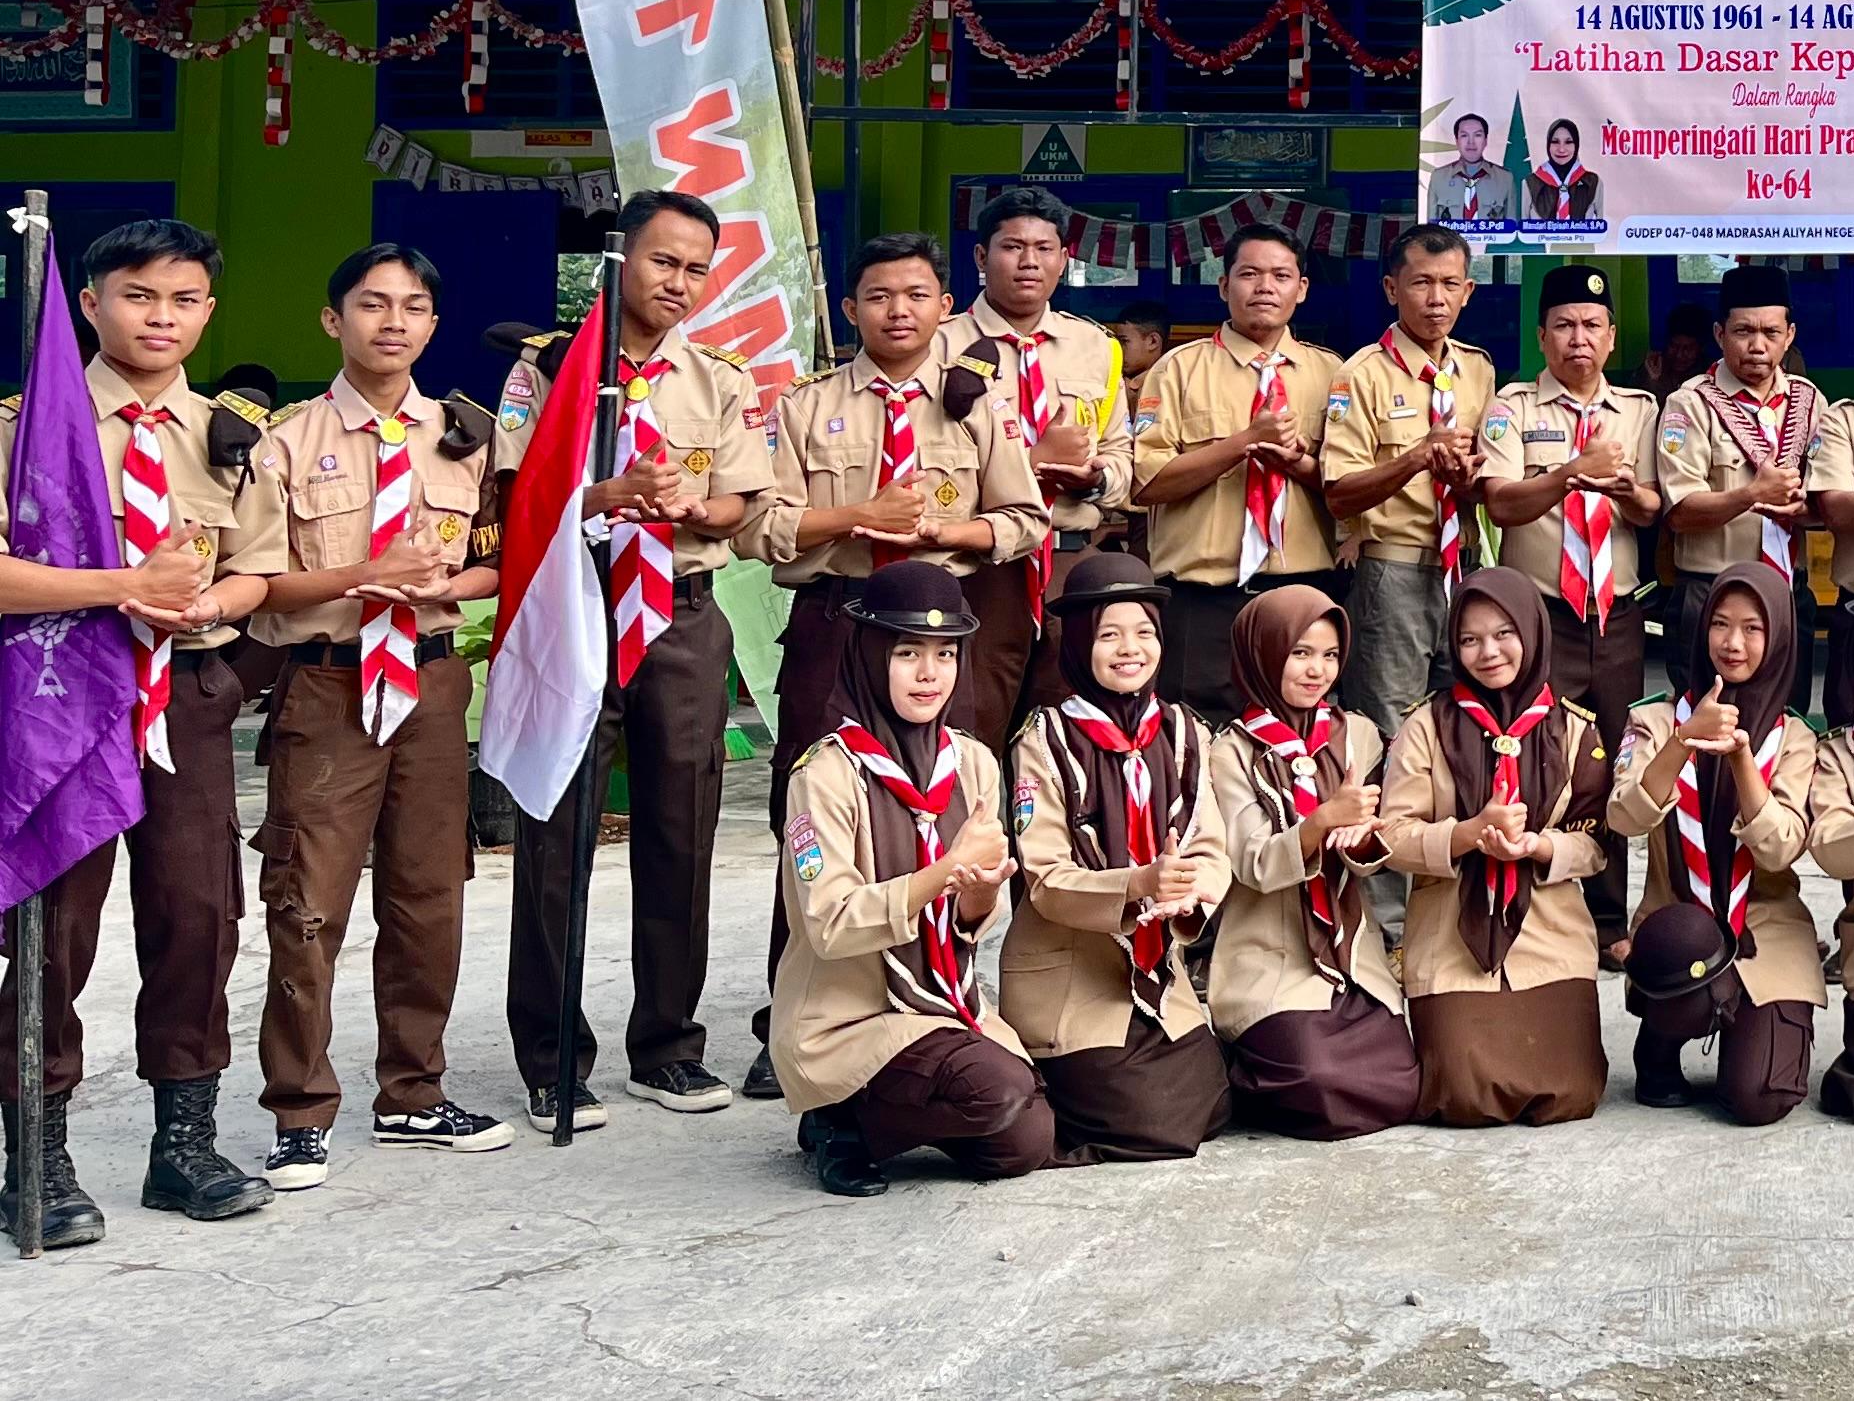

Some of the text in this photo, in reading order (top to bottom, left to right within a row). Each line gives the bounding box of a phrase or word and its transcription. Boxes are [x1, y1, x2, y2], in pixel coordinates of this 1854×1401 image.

[1575, 4, 1602, 30] 14
[1609, 4, 1705, 30] AGUSTUS
[1711, 4, 1763, 30] 1961
[1788, 4, 1815, 29] 14
[1514, 41, 1666, 72] “Latihan
[1677, 42, 1780, 72] Dasar
[1731, 81, 1837, 118] Dalam Rangka
[1040, 151, 1069, 161] UKM
[1601, 123, 1756, 160] Memperingati
[1763, 123, 1812, 155] Hari
[1746, 168, 1812, 199] ke-64
[1625, 227, 1663, 239] GUDEP
[1664, 227, 1714, 239] 047-048
[1715, 227, 1780, 239] MADRASAH
[1782, 226, 1823, 238] ALIYAH
[470, 522, 503, 558] PEM
